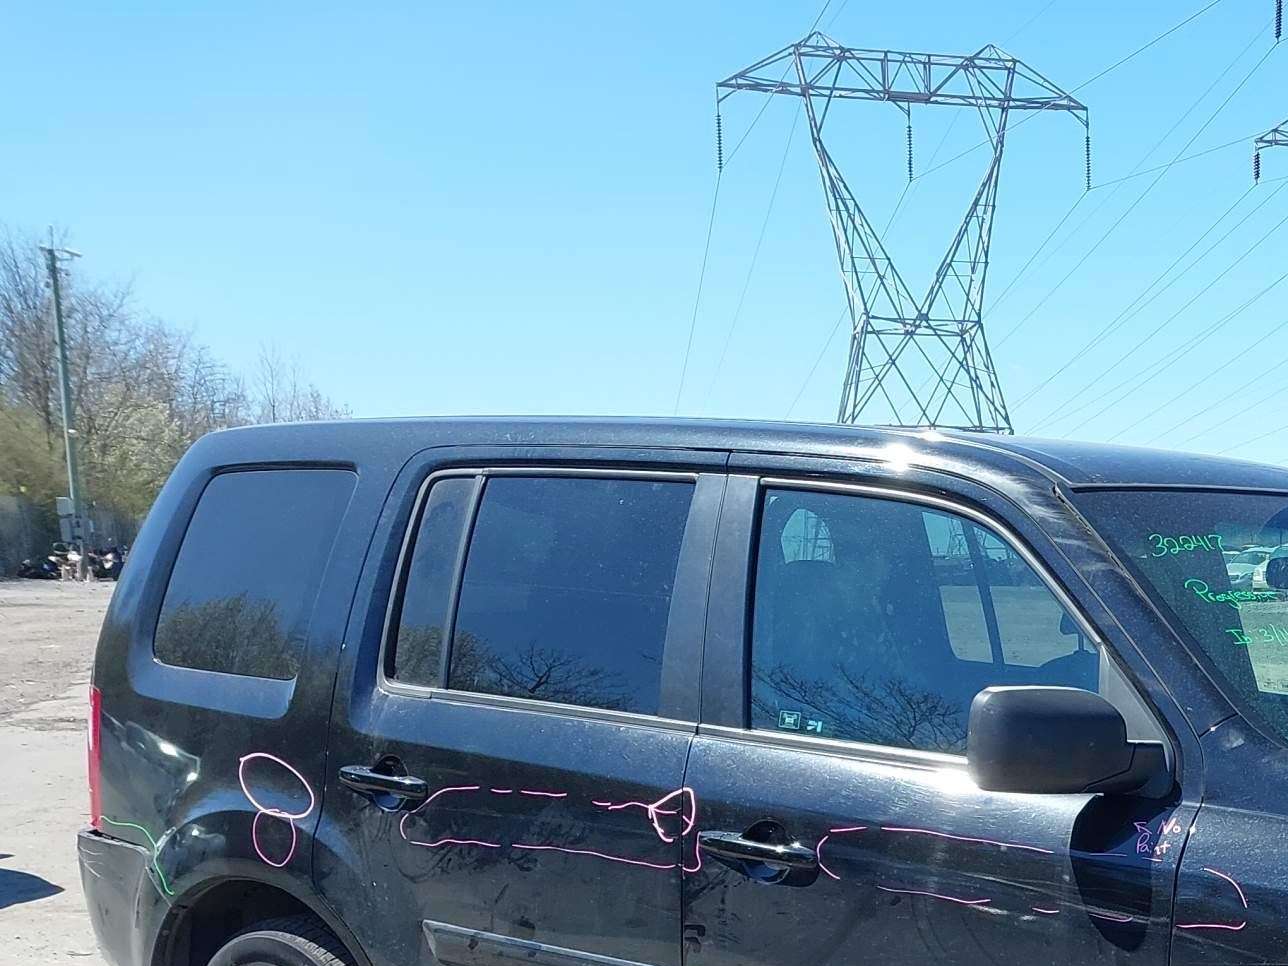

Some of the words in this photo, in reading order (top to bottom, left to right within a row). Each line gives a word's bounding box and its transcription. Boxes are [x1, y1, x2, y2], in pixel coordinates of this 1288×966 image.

[1148, 533, 1225, 558] 322417
[1157, 817, 1182, 835] No
[1136, 833, 1171, 856] Paint
